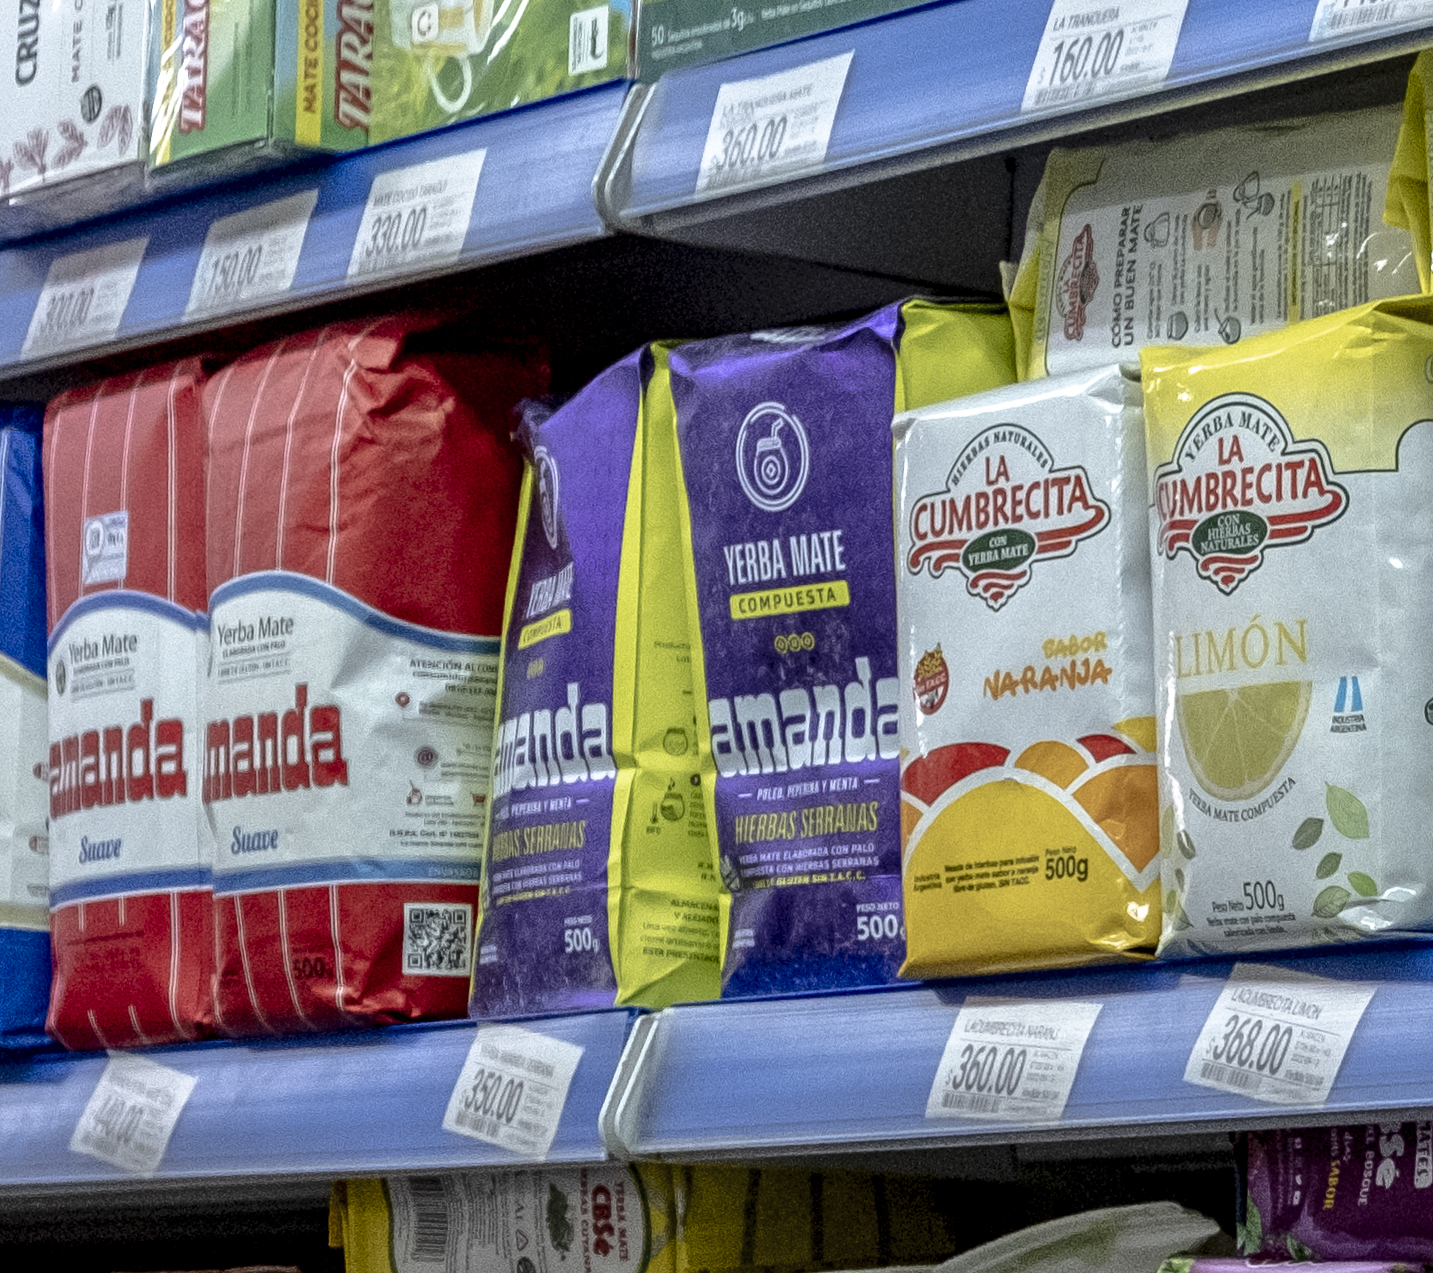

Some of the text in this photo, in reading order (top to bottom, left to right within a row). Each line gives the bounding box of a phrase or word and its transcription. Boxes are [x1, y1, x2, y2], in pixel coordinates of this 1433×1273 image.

[723, 529, 846, 586] YERBA MATE
[737, 586, 839, 610] COMPUESTA
[1174, 615, 1310, 678] LIMÓN
[982, 660, 1113, 701] NARANJA
[711, 657, 898, 778] amanda
[230, 825, 278, 855] Suave
[734, 801, 879, 842] HIERBAS SERRANAS
[1242, 880, 1284, 912] 500g
